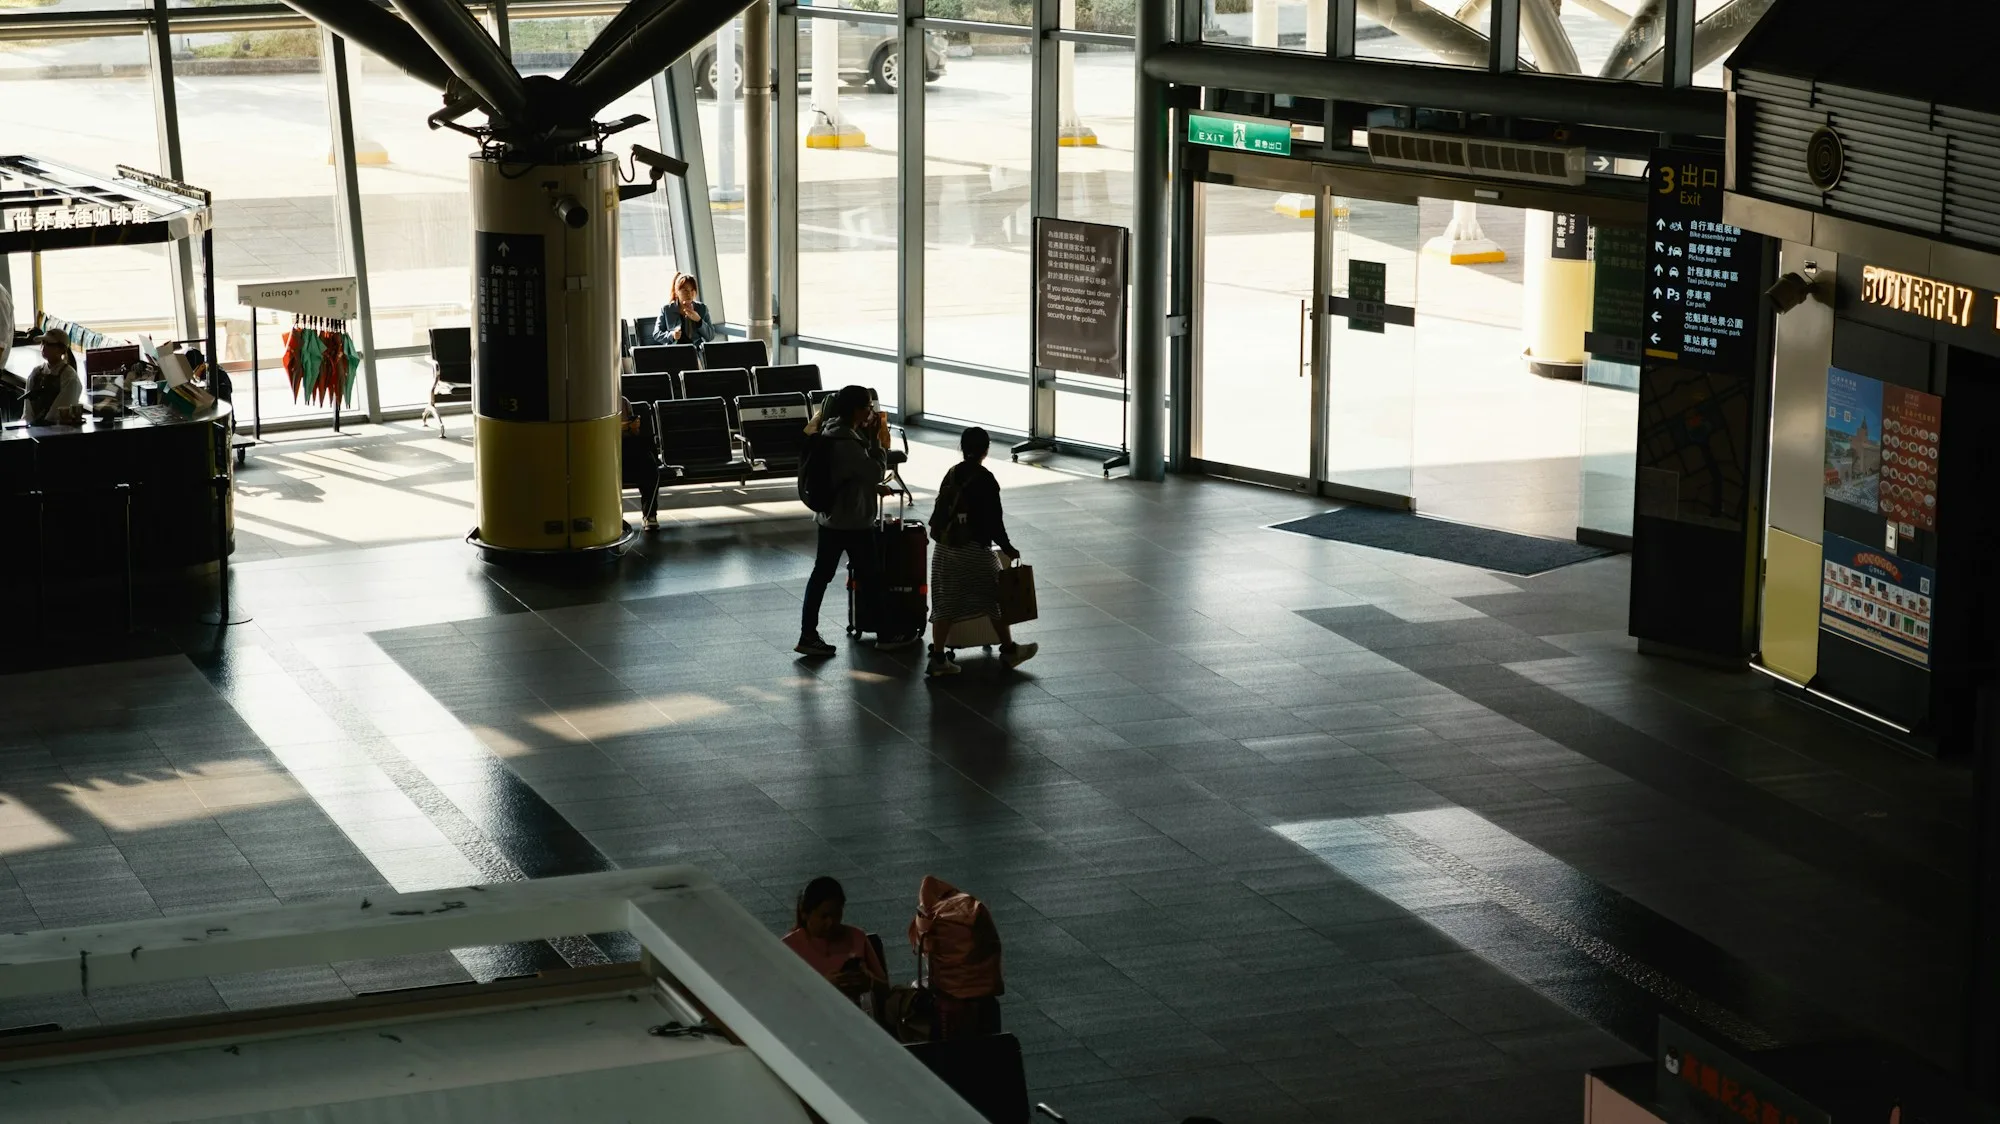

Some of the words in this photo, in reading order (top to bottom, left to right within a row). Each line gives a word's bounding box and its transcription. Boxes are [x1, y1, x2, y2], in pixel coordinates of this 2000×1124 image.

[1198, 131, 1225, 143] EXIT
[1658, 166, 1675, 194] 3
[1681, 164, 1718, 188] 出口
[1680, 191, 1701, 206] Exit
[13, 204, 151, 232] 世界最佳咖啡館
[1726, 235, 1737, 243] area
[1688, 243, 1731, 257] 臨停載客區
[1688, 254, 1705, 263] Pickup
[1687, 266, 1739, 282] 計程車乘車區
[1698, 279, 1713, 287] pickup
[1667, 287, 1680, 301] P3
[1686, 289, 1711, 301] 停車場
[1861, 265, 1975, 328] BUTTERFLY
[1694, 301, 1706, 309] park
[1047, 312, 1065, 320] security
[1728, 329, 1741, 337] park
[1683, 345, 1702, 353] Station
[1703, 347, 1716, 356] plaza
